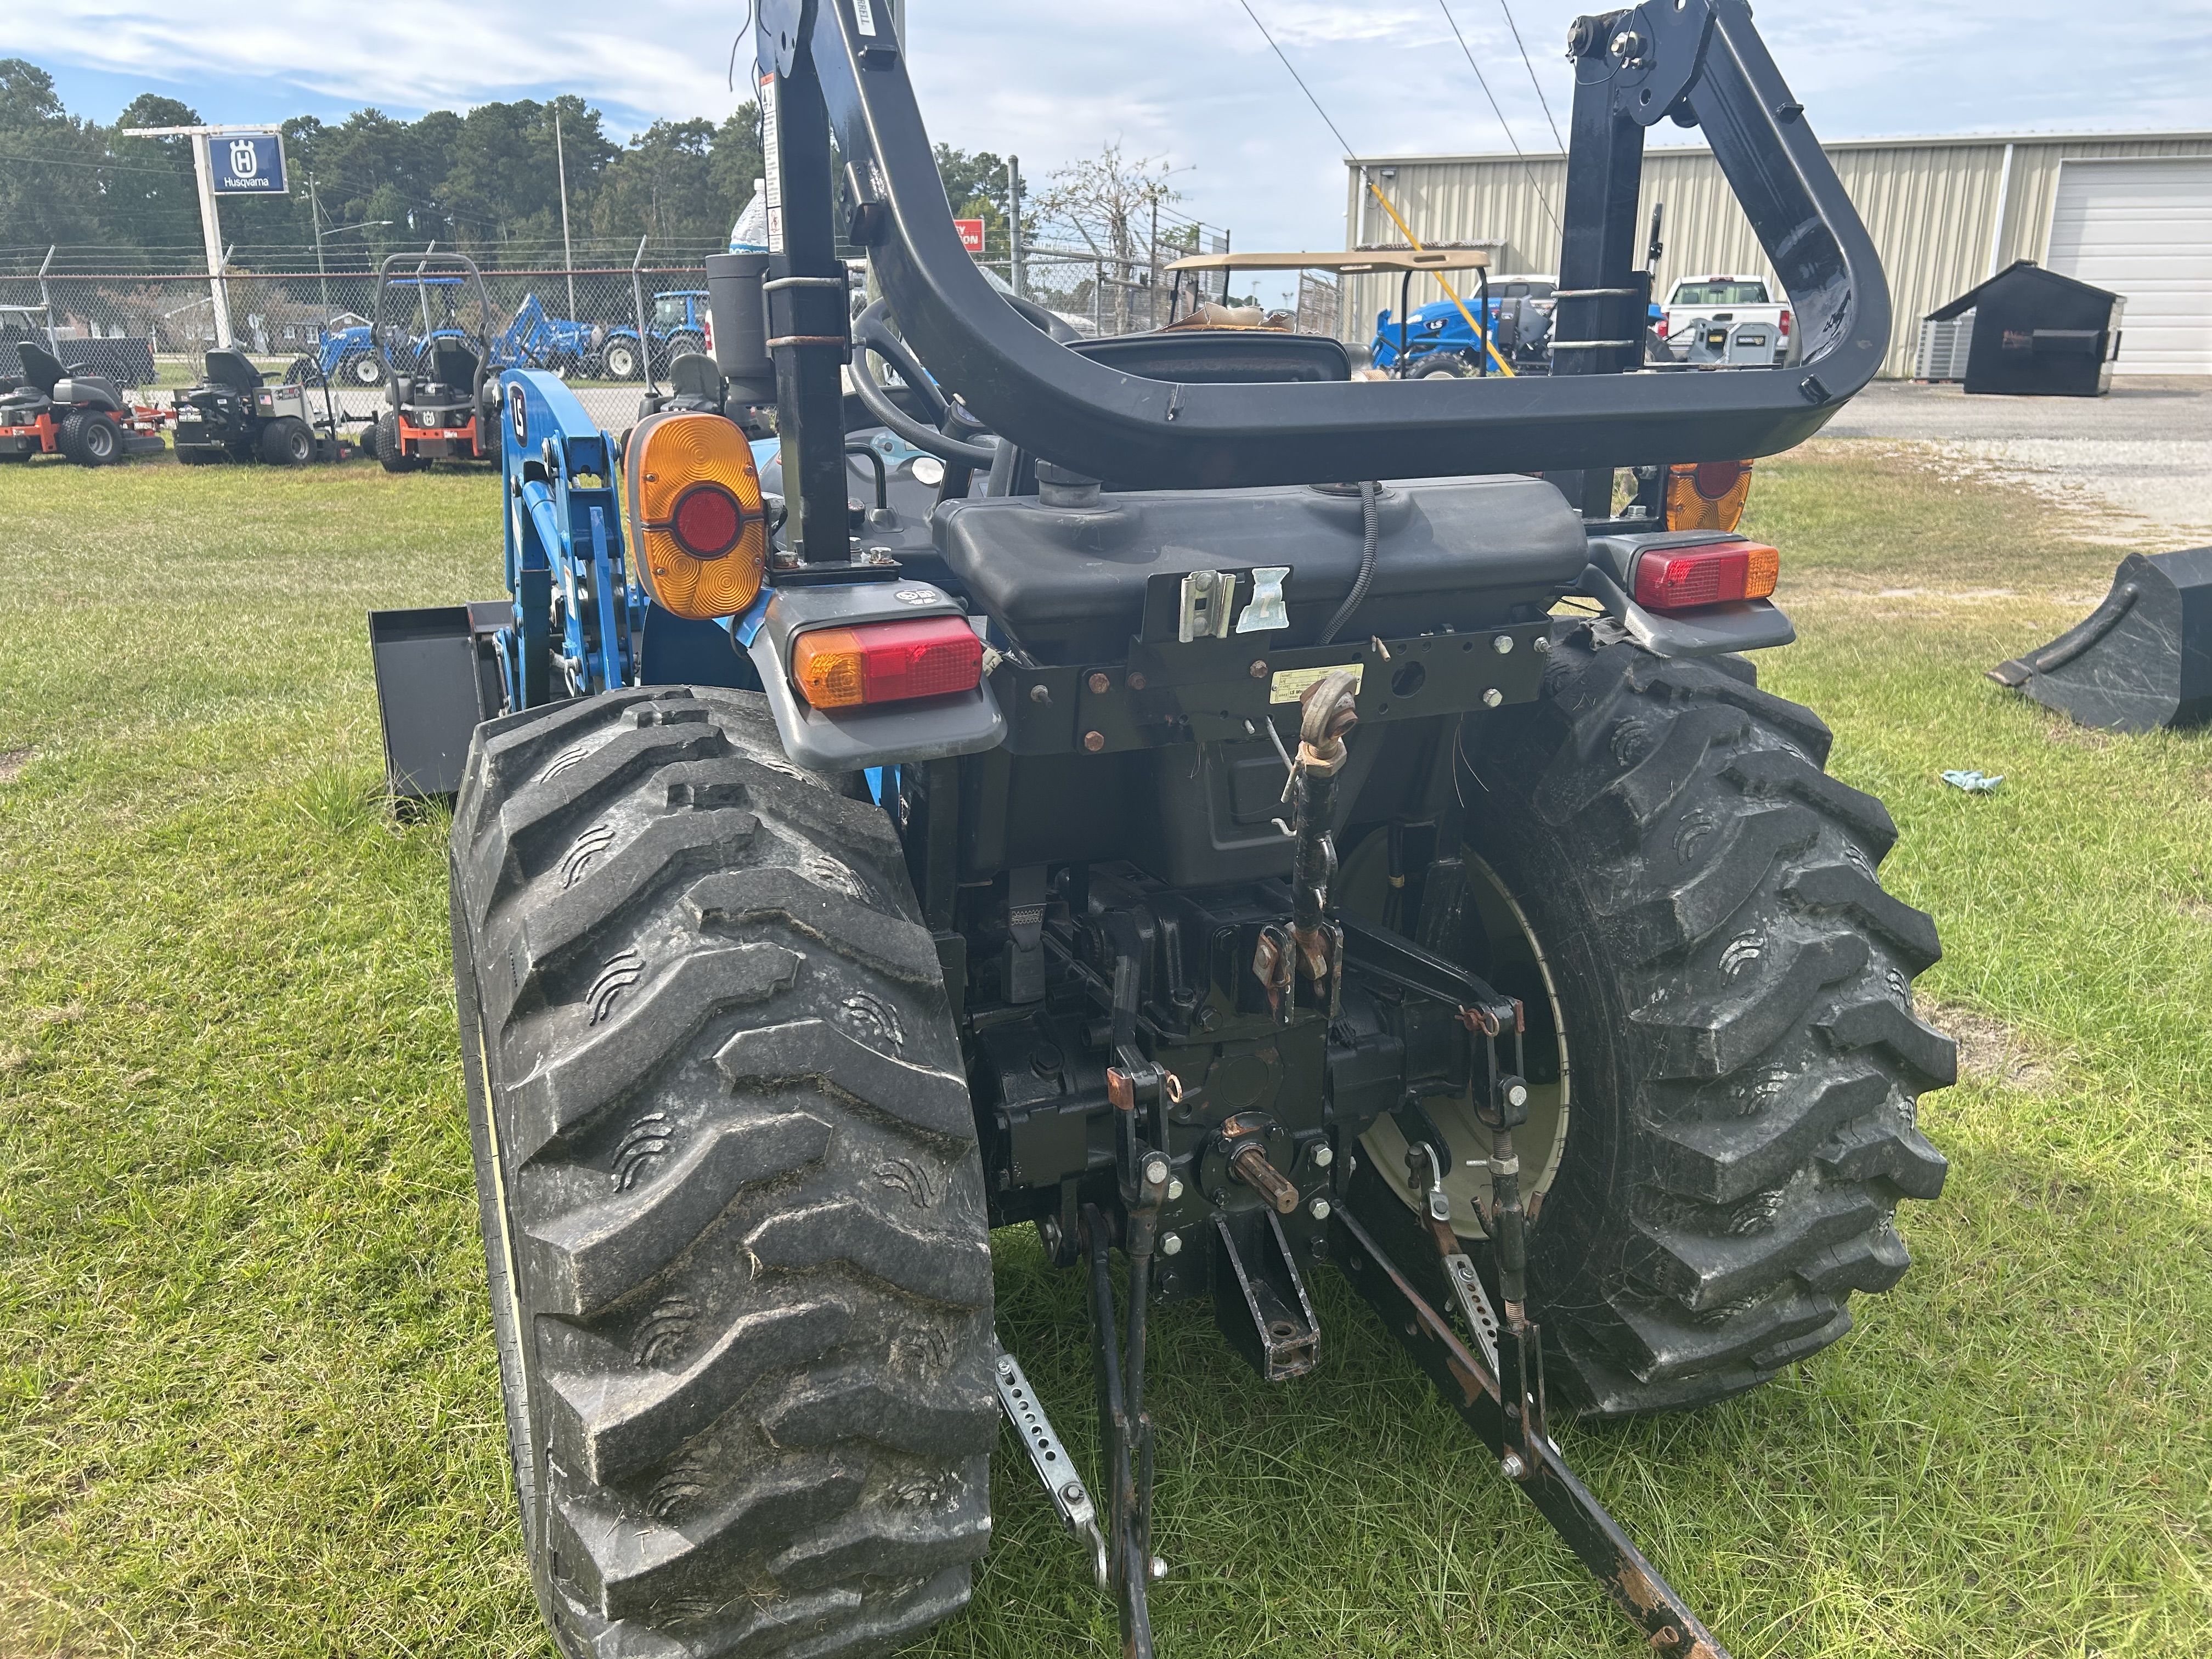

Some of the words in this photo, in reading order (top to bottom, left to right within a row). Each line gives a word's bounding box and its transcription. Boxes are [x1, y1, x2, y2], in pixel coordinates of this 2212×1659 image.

[224, 177, 269, 188] Husqvarna
[956, 225, 966, 235] Y
[961, 235, 979, 245] ON
[1430, 320, 1443, 330] LS
[513, 397, 524, 437] LS
